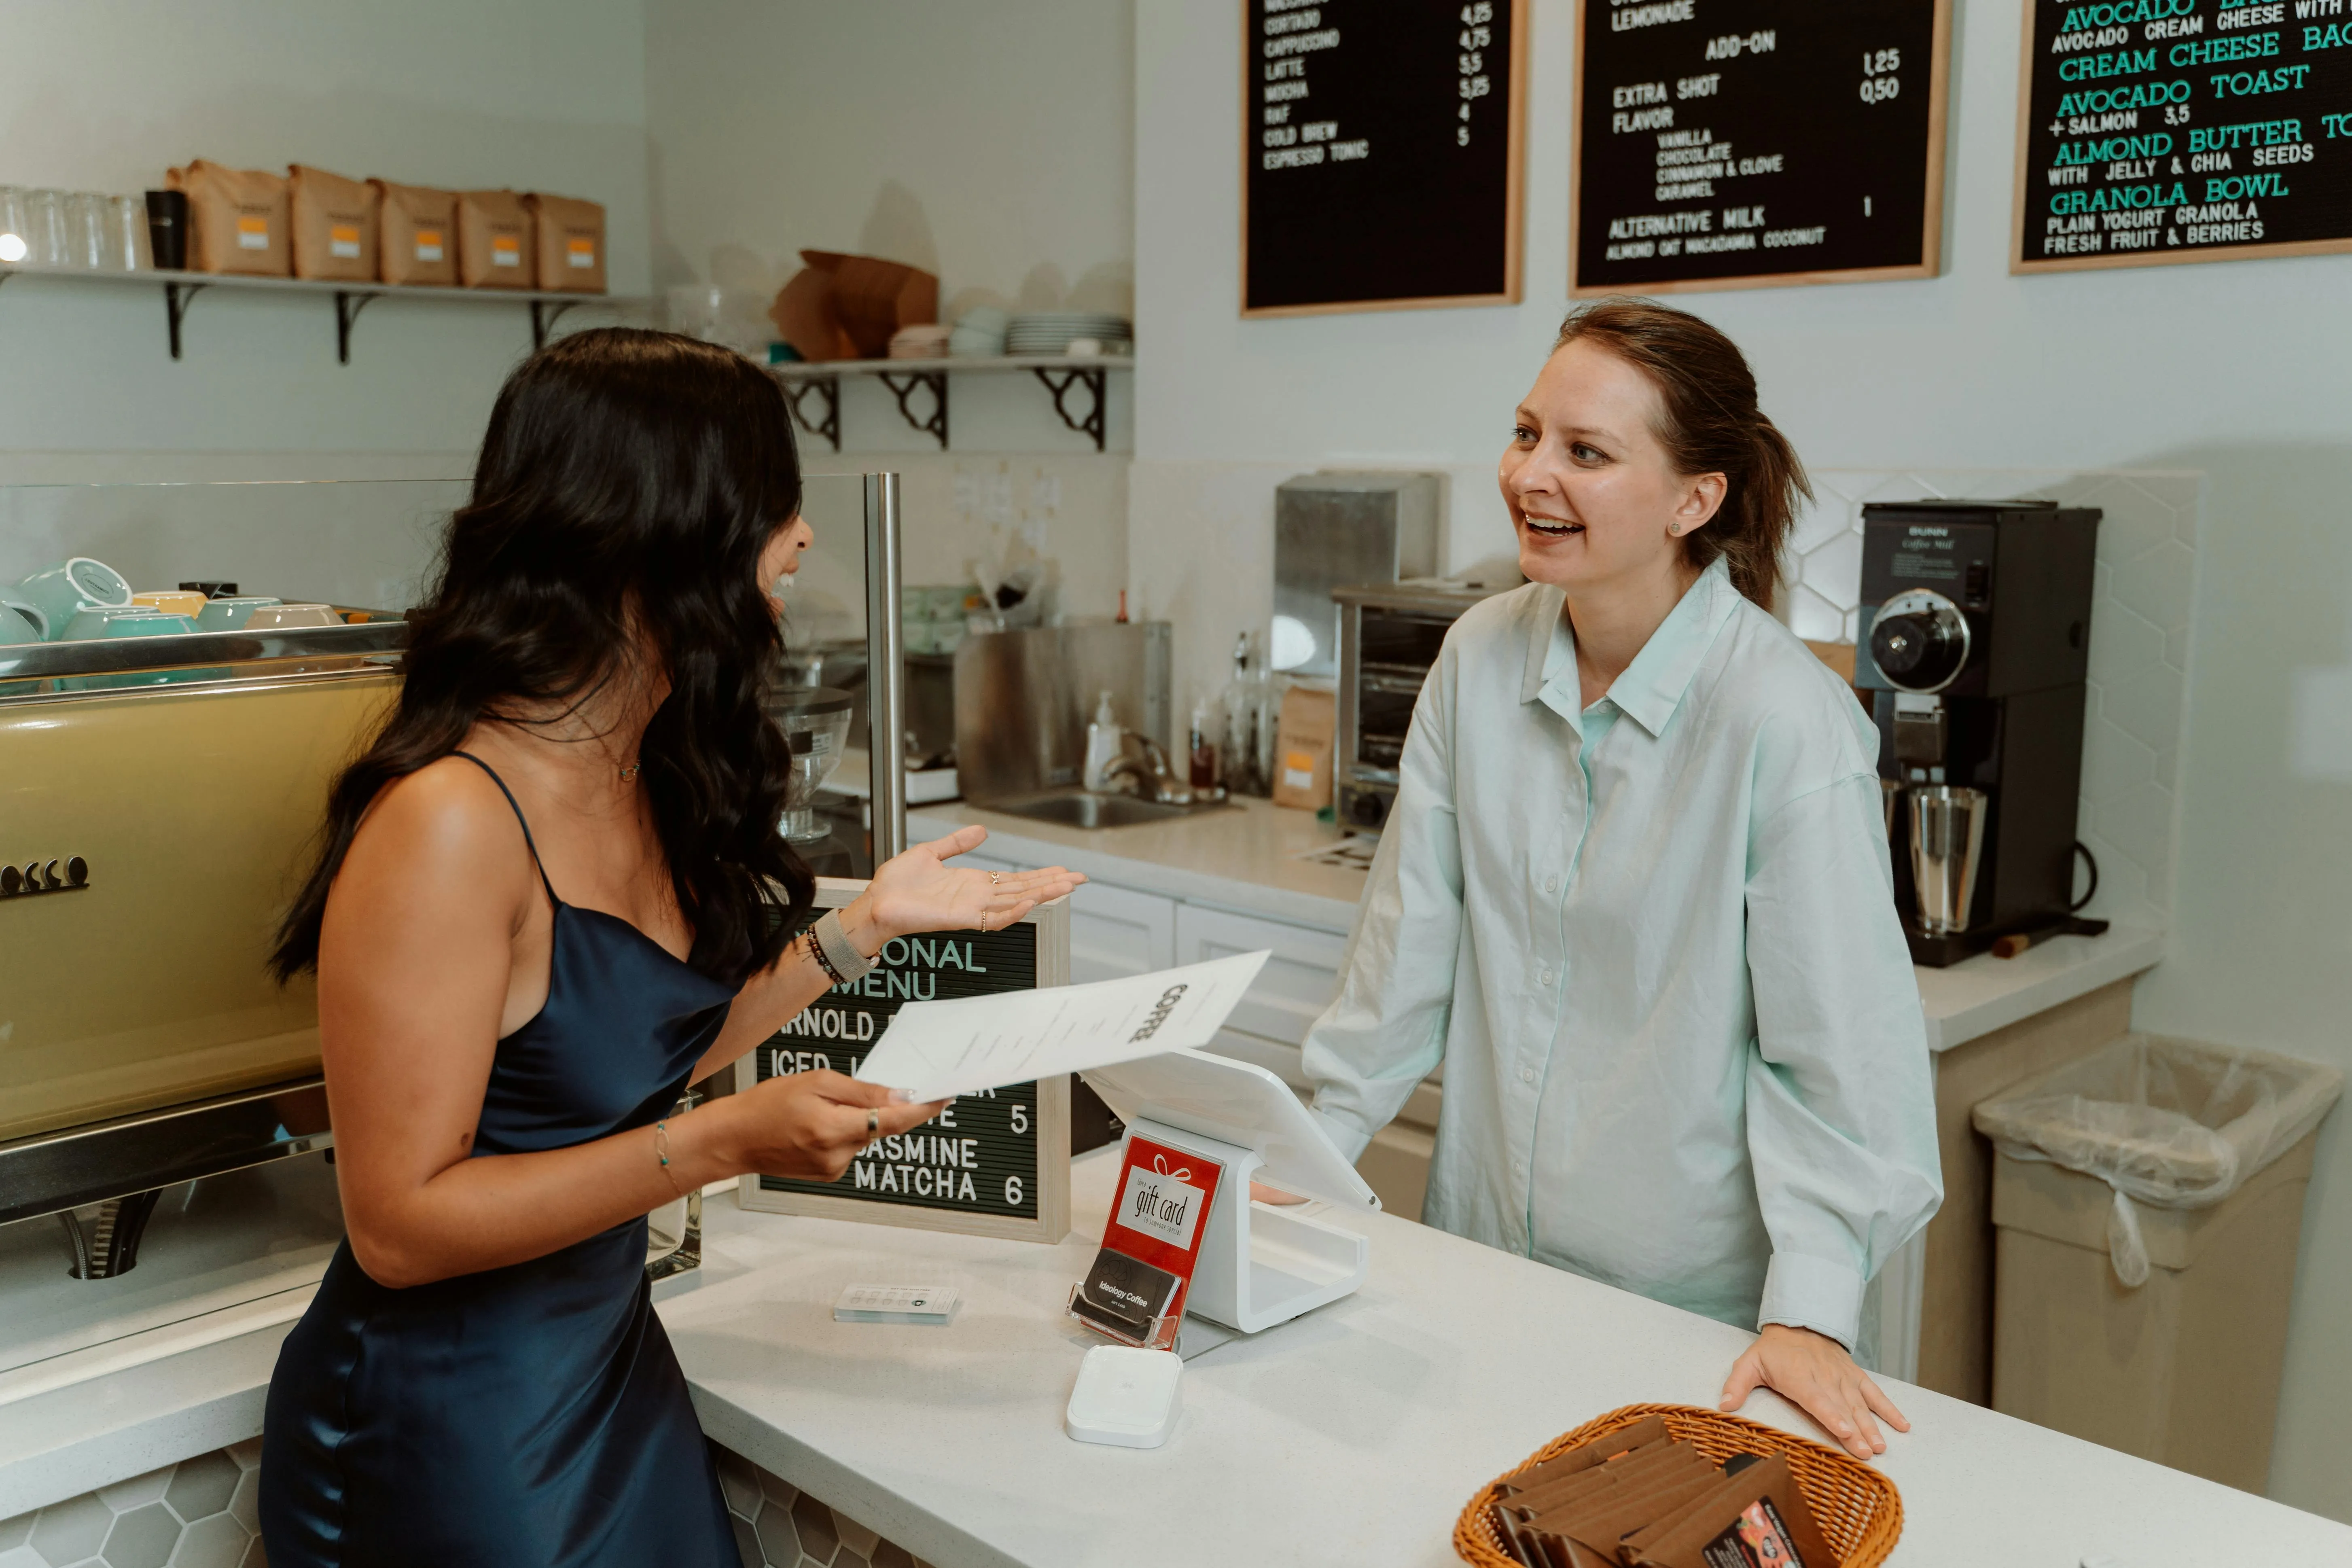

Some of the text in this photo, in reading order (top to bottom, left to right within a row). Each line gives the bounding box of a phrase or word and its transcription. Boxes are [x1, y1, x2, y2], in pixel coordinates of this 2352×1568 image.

[1612, 0, 1695, 32] LEMONADE
[2051, 26, 2129, 54] AVOCADO
[2144, 15, 2204, 41] CREAM
[2217, 3, 2285, 30] CHEESE
[2295, 0, 2342, 19] WITH
[2061, 0, 2195, 32] AVOCADO
[1705, 30, 1776, 61] ADD-ON
[2059, 47, 2157, 82] CREAM
[2169, 32, 2280, 67] CHEESE
[1265, 56, 1306, 81] LATTE
[1264, 79, 1309, 103] MOCHA
[1613, 82, 1668, 108] EXTRA
[1677, 73, 1721, 100] SHOT
[2056, 64, 2310, 117] AVOCADO TOAST
[1263, 102, 1470, 148] COLD BREW 4
[1613, 107, 1674, 134] FLAVOR
[1263, 126, 1469, 170] ESPRESSO TONIC 5
[1656, 142, 1733, 167] CHOCOLATE
[1657, 128, 1712, 149] VANILLA
[2054, 133, 2173, 166] ALMOND
[2189, 119, 2303, 153] BUTTER
[1656, 154, 1784, 184] CINNAMON & CLOVE
[2048, 144, 2314, 186] WITH JELLY & CHIA SEEDS
[1655, 180, 1716, 201] CARAMEL
[2050, 174, 2289, 214] GRANOLA BOWL
[1608, 196, 1872, 239] ALTERNATIVE MILK 1
[2047, 201, 2259, 235] PLAIN YOGURT GRANOLA
[1606, 226, 1827, 261] ALMOND OAT MACADAMIA COCONUT
[2044, 221, 2264, 254] FRESH FRUIT & BERRIES
[1909, 526, 1948, 537] BUNN
[781, 1007, 874, 1041] RNOLD
[1127, 984, 1188, 1044] COFFEE
[1011, 1105, 1028, 1134] 5
[855, 1160, 1023, 1205] MATCHA 6
[1135, 1185, 1188, 1226] gift card
[1149, 1219, 1166, 1229] someone
[1167, 1226, 1182, 1236] special
[1099, 1280, 1148, 1307] Ideology Coffee
[1765, 1504, 1776, 1521] Raw
[1773, 1519, 1787, 1539] Vegan
